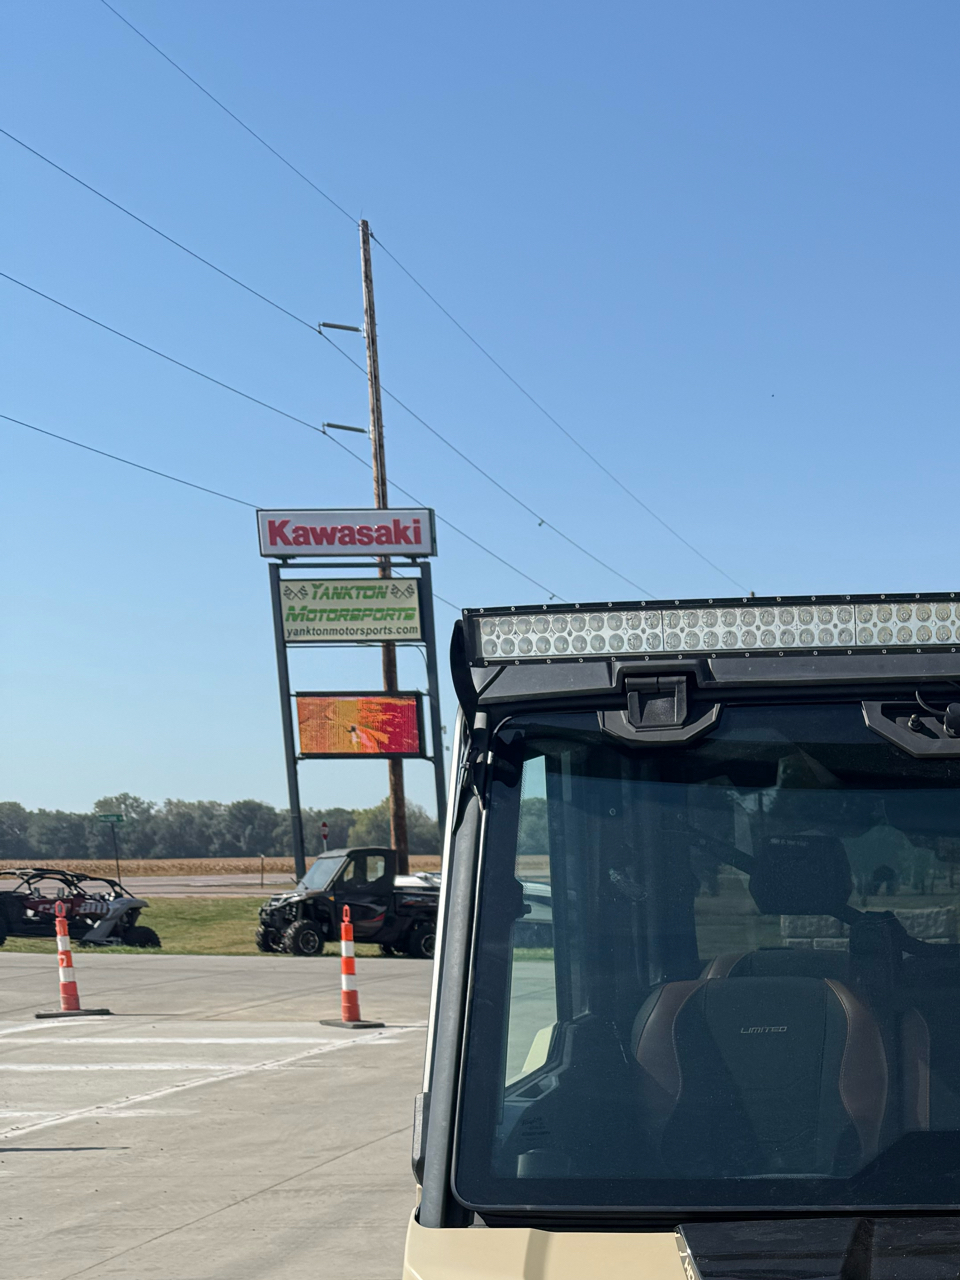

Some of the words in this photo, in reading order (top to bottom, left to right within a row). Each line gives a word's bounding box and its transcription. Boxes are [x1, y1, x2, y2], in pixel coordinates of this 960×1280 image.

[267, 518, 422, 546] Kawasaki
[311, 583, 389, 600] YANKTON
[285, 605, 417, 622] MOTORSPORTS
[286, 624, 419, 638] yanktonmotorsports.com
[740, 1026, 788, 1034] LIMITED
